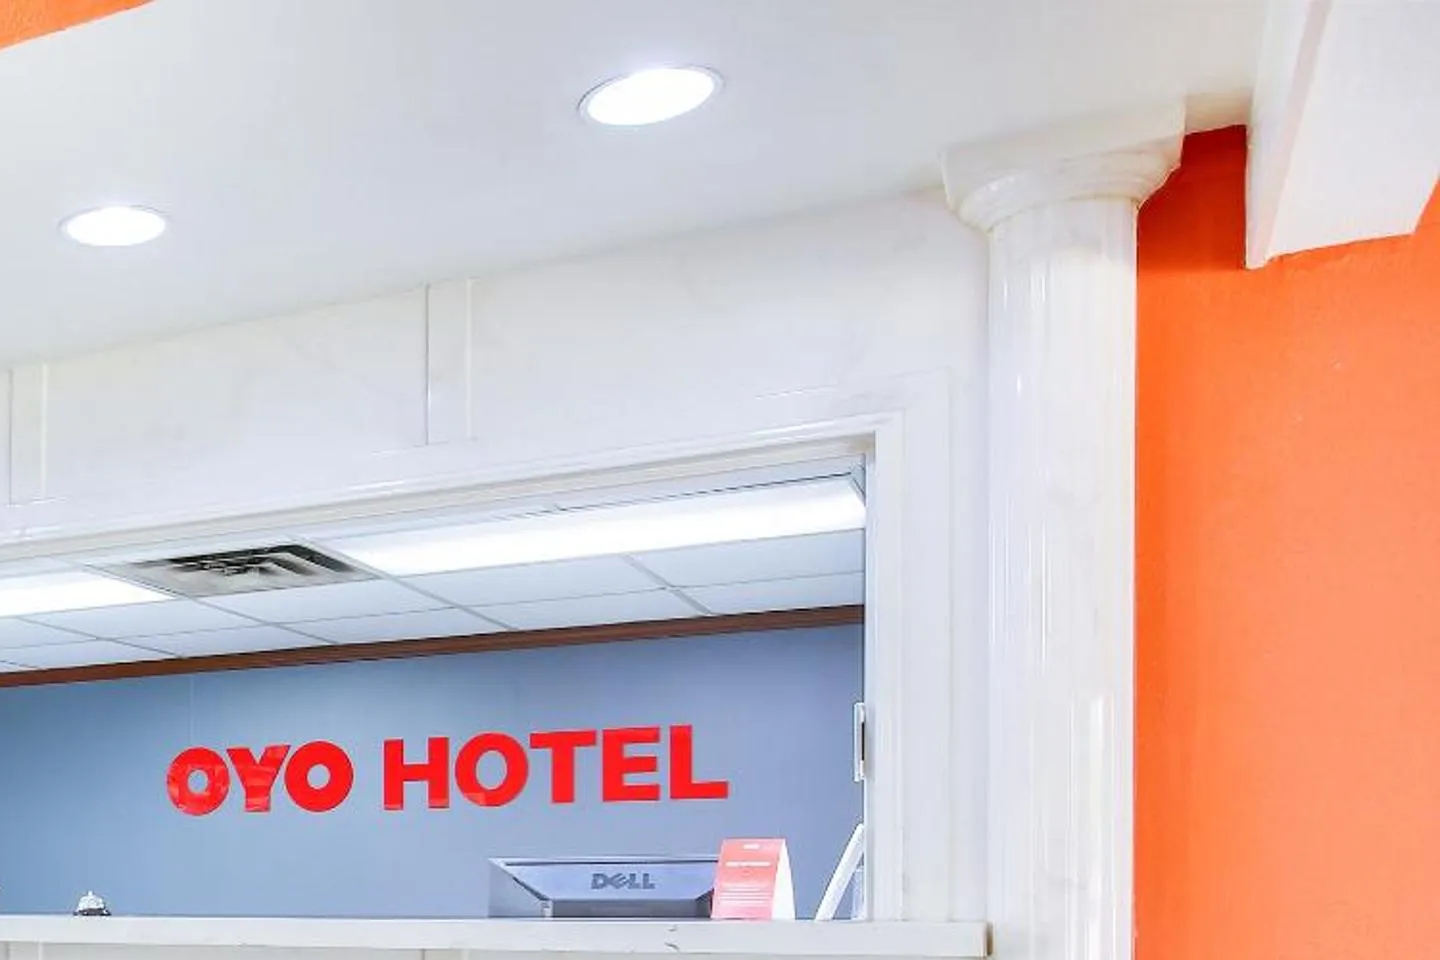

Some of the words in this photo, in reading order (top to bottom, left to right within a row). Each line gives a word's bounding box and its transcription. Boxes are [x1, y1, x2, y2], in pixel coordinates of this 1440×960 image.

[166, 740, 355, 816] OYO
[383, 724, 730, 811] HOTEL
[590, 872, 656, 890] DELL
